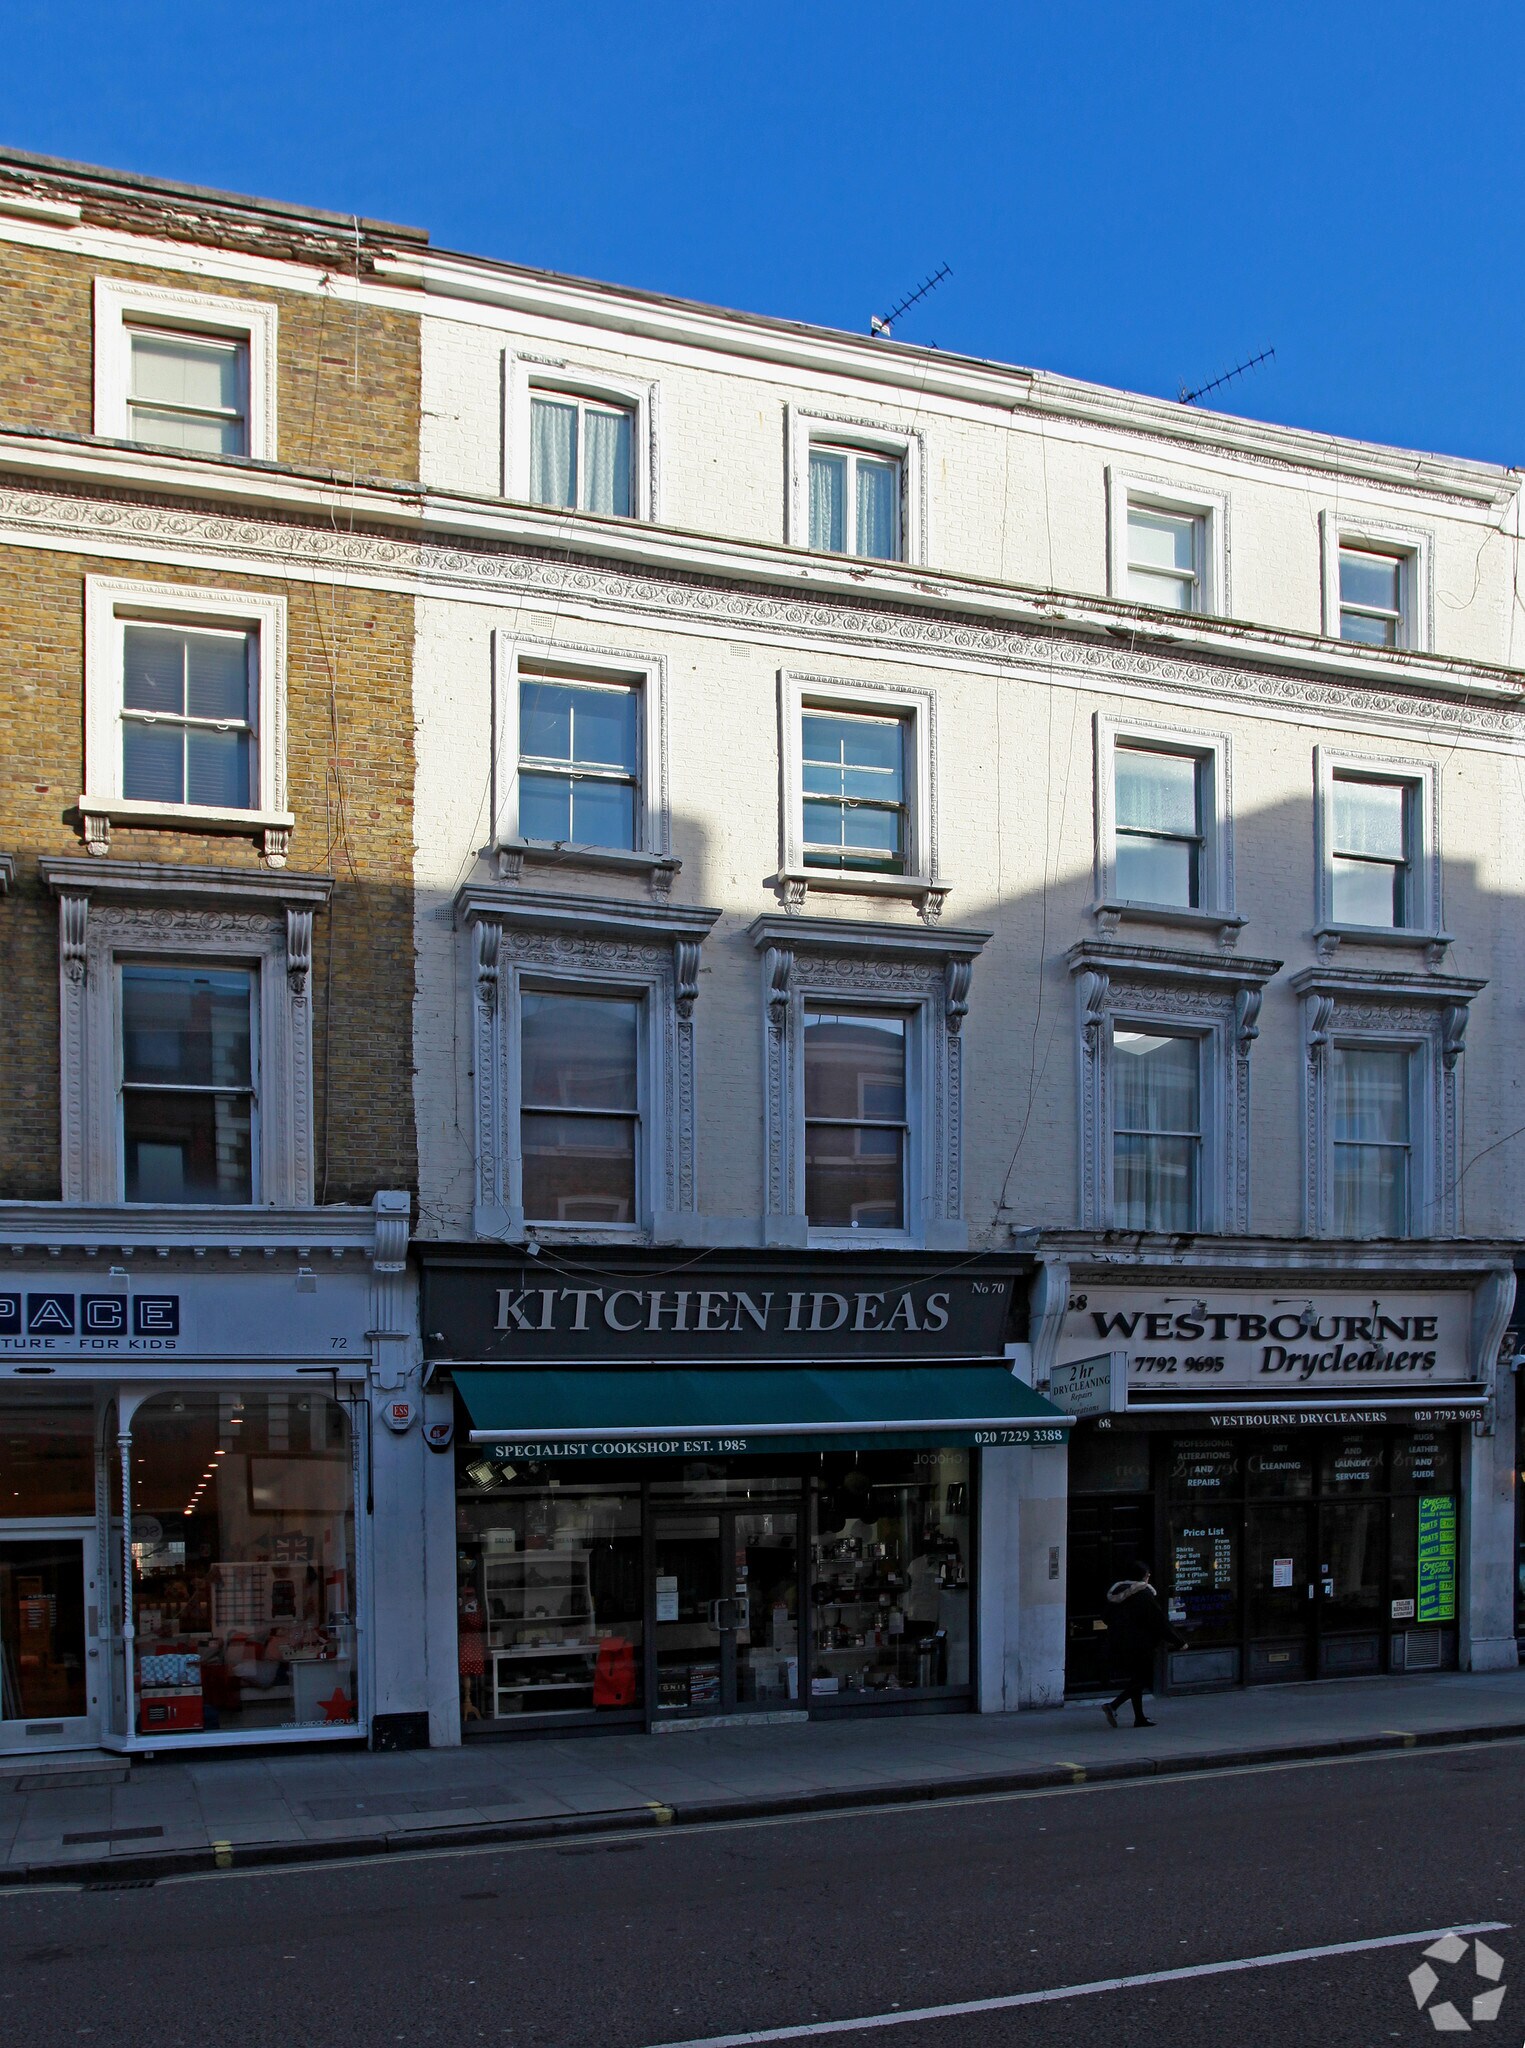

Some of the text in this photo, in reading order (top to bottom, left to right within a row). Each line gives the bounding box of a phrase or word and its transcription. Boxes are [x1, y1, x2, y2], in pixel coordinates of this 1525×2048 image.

[971, 1282, 1005, 1294] No 70
[494, 1287, 950, 1331] KITCHEN IDEAS
[1091, 1311, 1439, 1343] WESTBOURNE
[81, 1339, 120, 1349] FOR
[130, 1339, 178, 1349] KIDS
[330, 1337, 347, 1349] 72
[1135, 1356, 1178, 1373] 7792
[1184, 1356, 1225, 1373] 9695
[1260, 1344, 1437, 1380] Drycleaners
[1069, 1364, 1094, 1382] 2 hr
[1053, 1375, 1110, 1396] DRYCLEANING
[1070, 1391, 1093, 1402] Repairs
[394, 1405, 408, 1416] ESS
[1414, 1409, 1482, 1421] 020 7792 9695
[1098, 1418, 1112, 1429] 68
[1210, 1411, 1387, 1427] WESTBOURNE DRYCLEANERS
[974, 1428, 1063, 1444] 020 7229 3388
[1413, 1433, 1434, 1441] RUGS
[495, 1439, 748, 1457] SPECIALIST COOKSHOP EST. 1985
[1173, 1439, 1234, 1448] PROFESSIONAL
[1272, 1444, 1289, 1453] DRY
[1344, 1447, 1362, 1455] AND
[1408, 1445, 1439, 1454] LEATHER
[1177, 1451, 1231, 1460] ALTERATIONS
[1260, 1461, 1301, 1471] CLEANING
[1335, 1459, 1371, 1468] LAUNDRY
[1415, 1458, 1433, 1466] AND
[1194, 1465, 1214, 1474] AND
[1412, 1470, 1434, 1479] SUEDE
[1187, 1477, 1220, 1487] REPAIRS
[1335, 1472, 1370, 1481] SERVICES
[1421, 1497, 1450, 1509] SPECIAL
[1183, 1528, 1225, 1537] Price List
[280, 1717, 356, 1728] www.aspace.co.uk
